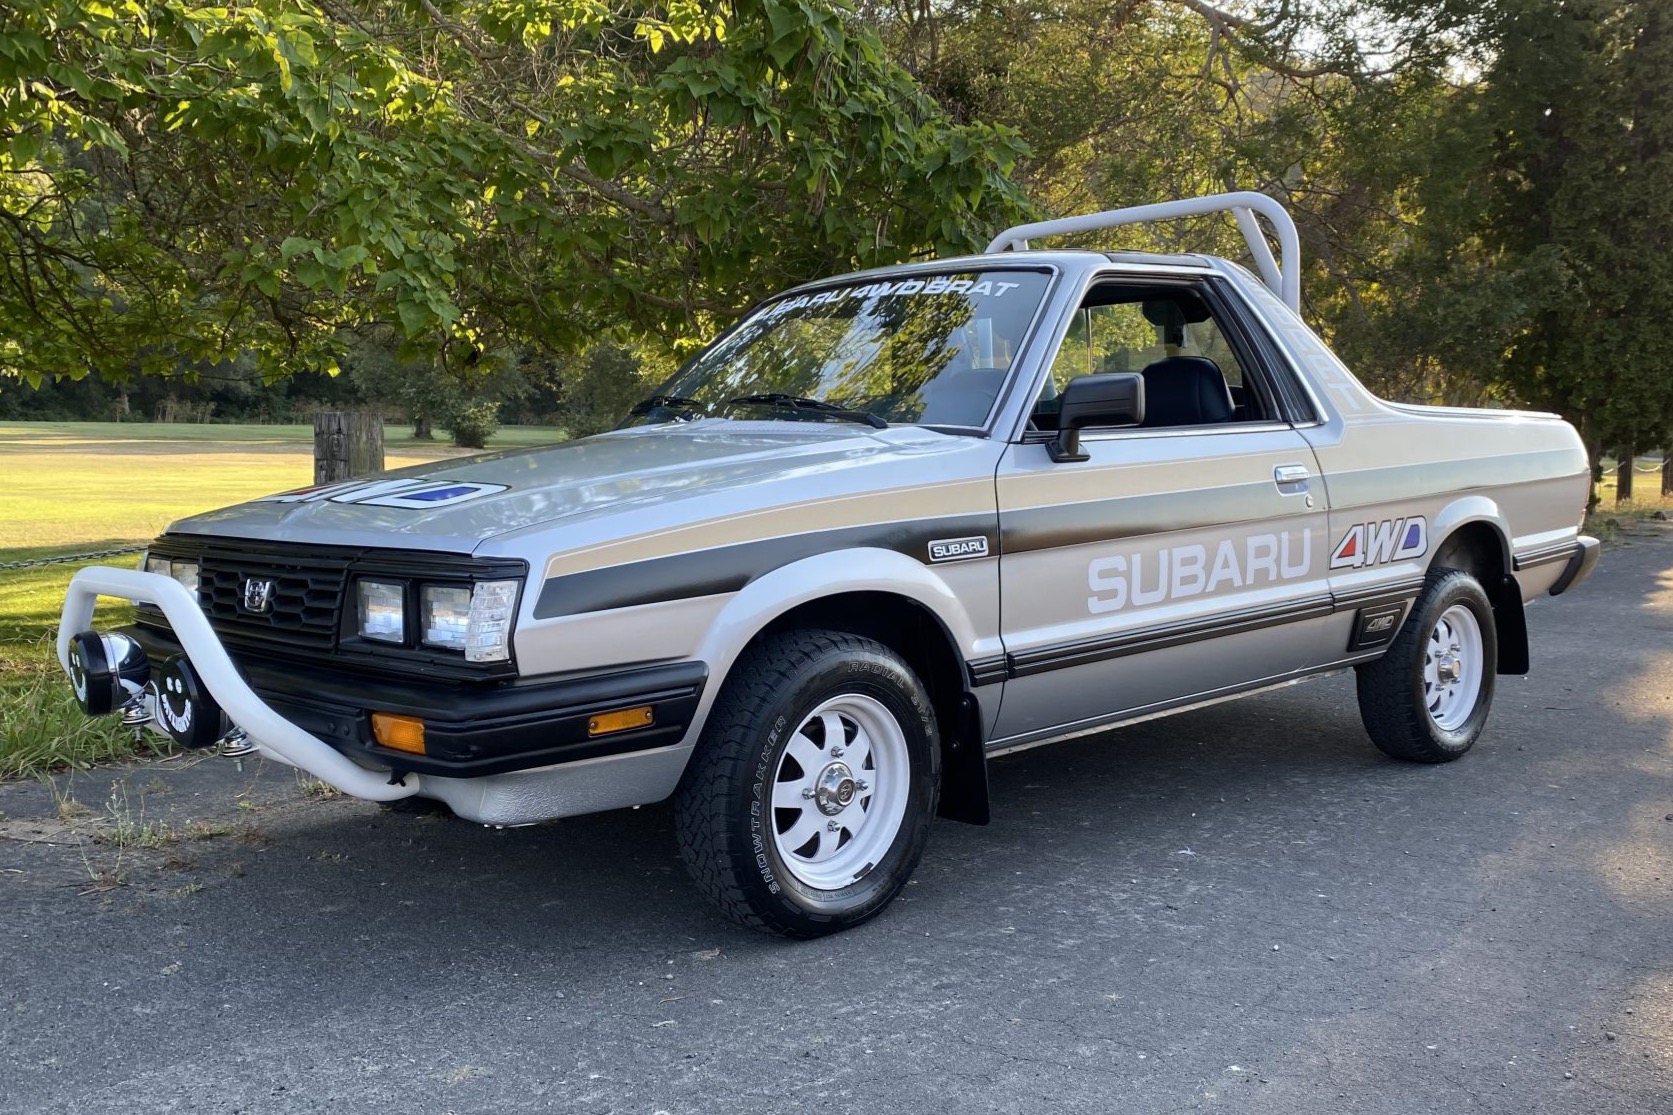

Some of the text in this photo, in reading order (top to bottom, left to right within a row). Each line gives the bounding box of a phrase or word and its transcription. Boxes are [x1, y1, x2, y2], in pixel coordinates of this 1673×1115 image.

[933, 541, 986, 557] SUBARU
[1329, 515, 1428, 570] 4WD
[1088, 528, 1311, 614] SUBARU
[1366, 615, 1395, 630] 4WD
[848, 661, 904, 689] RADIAL
